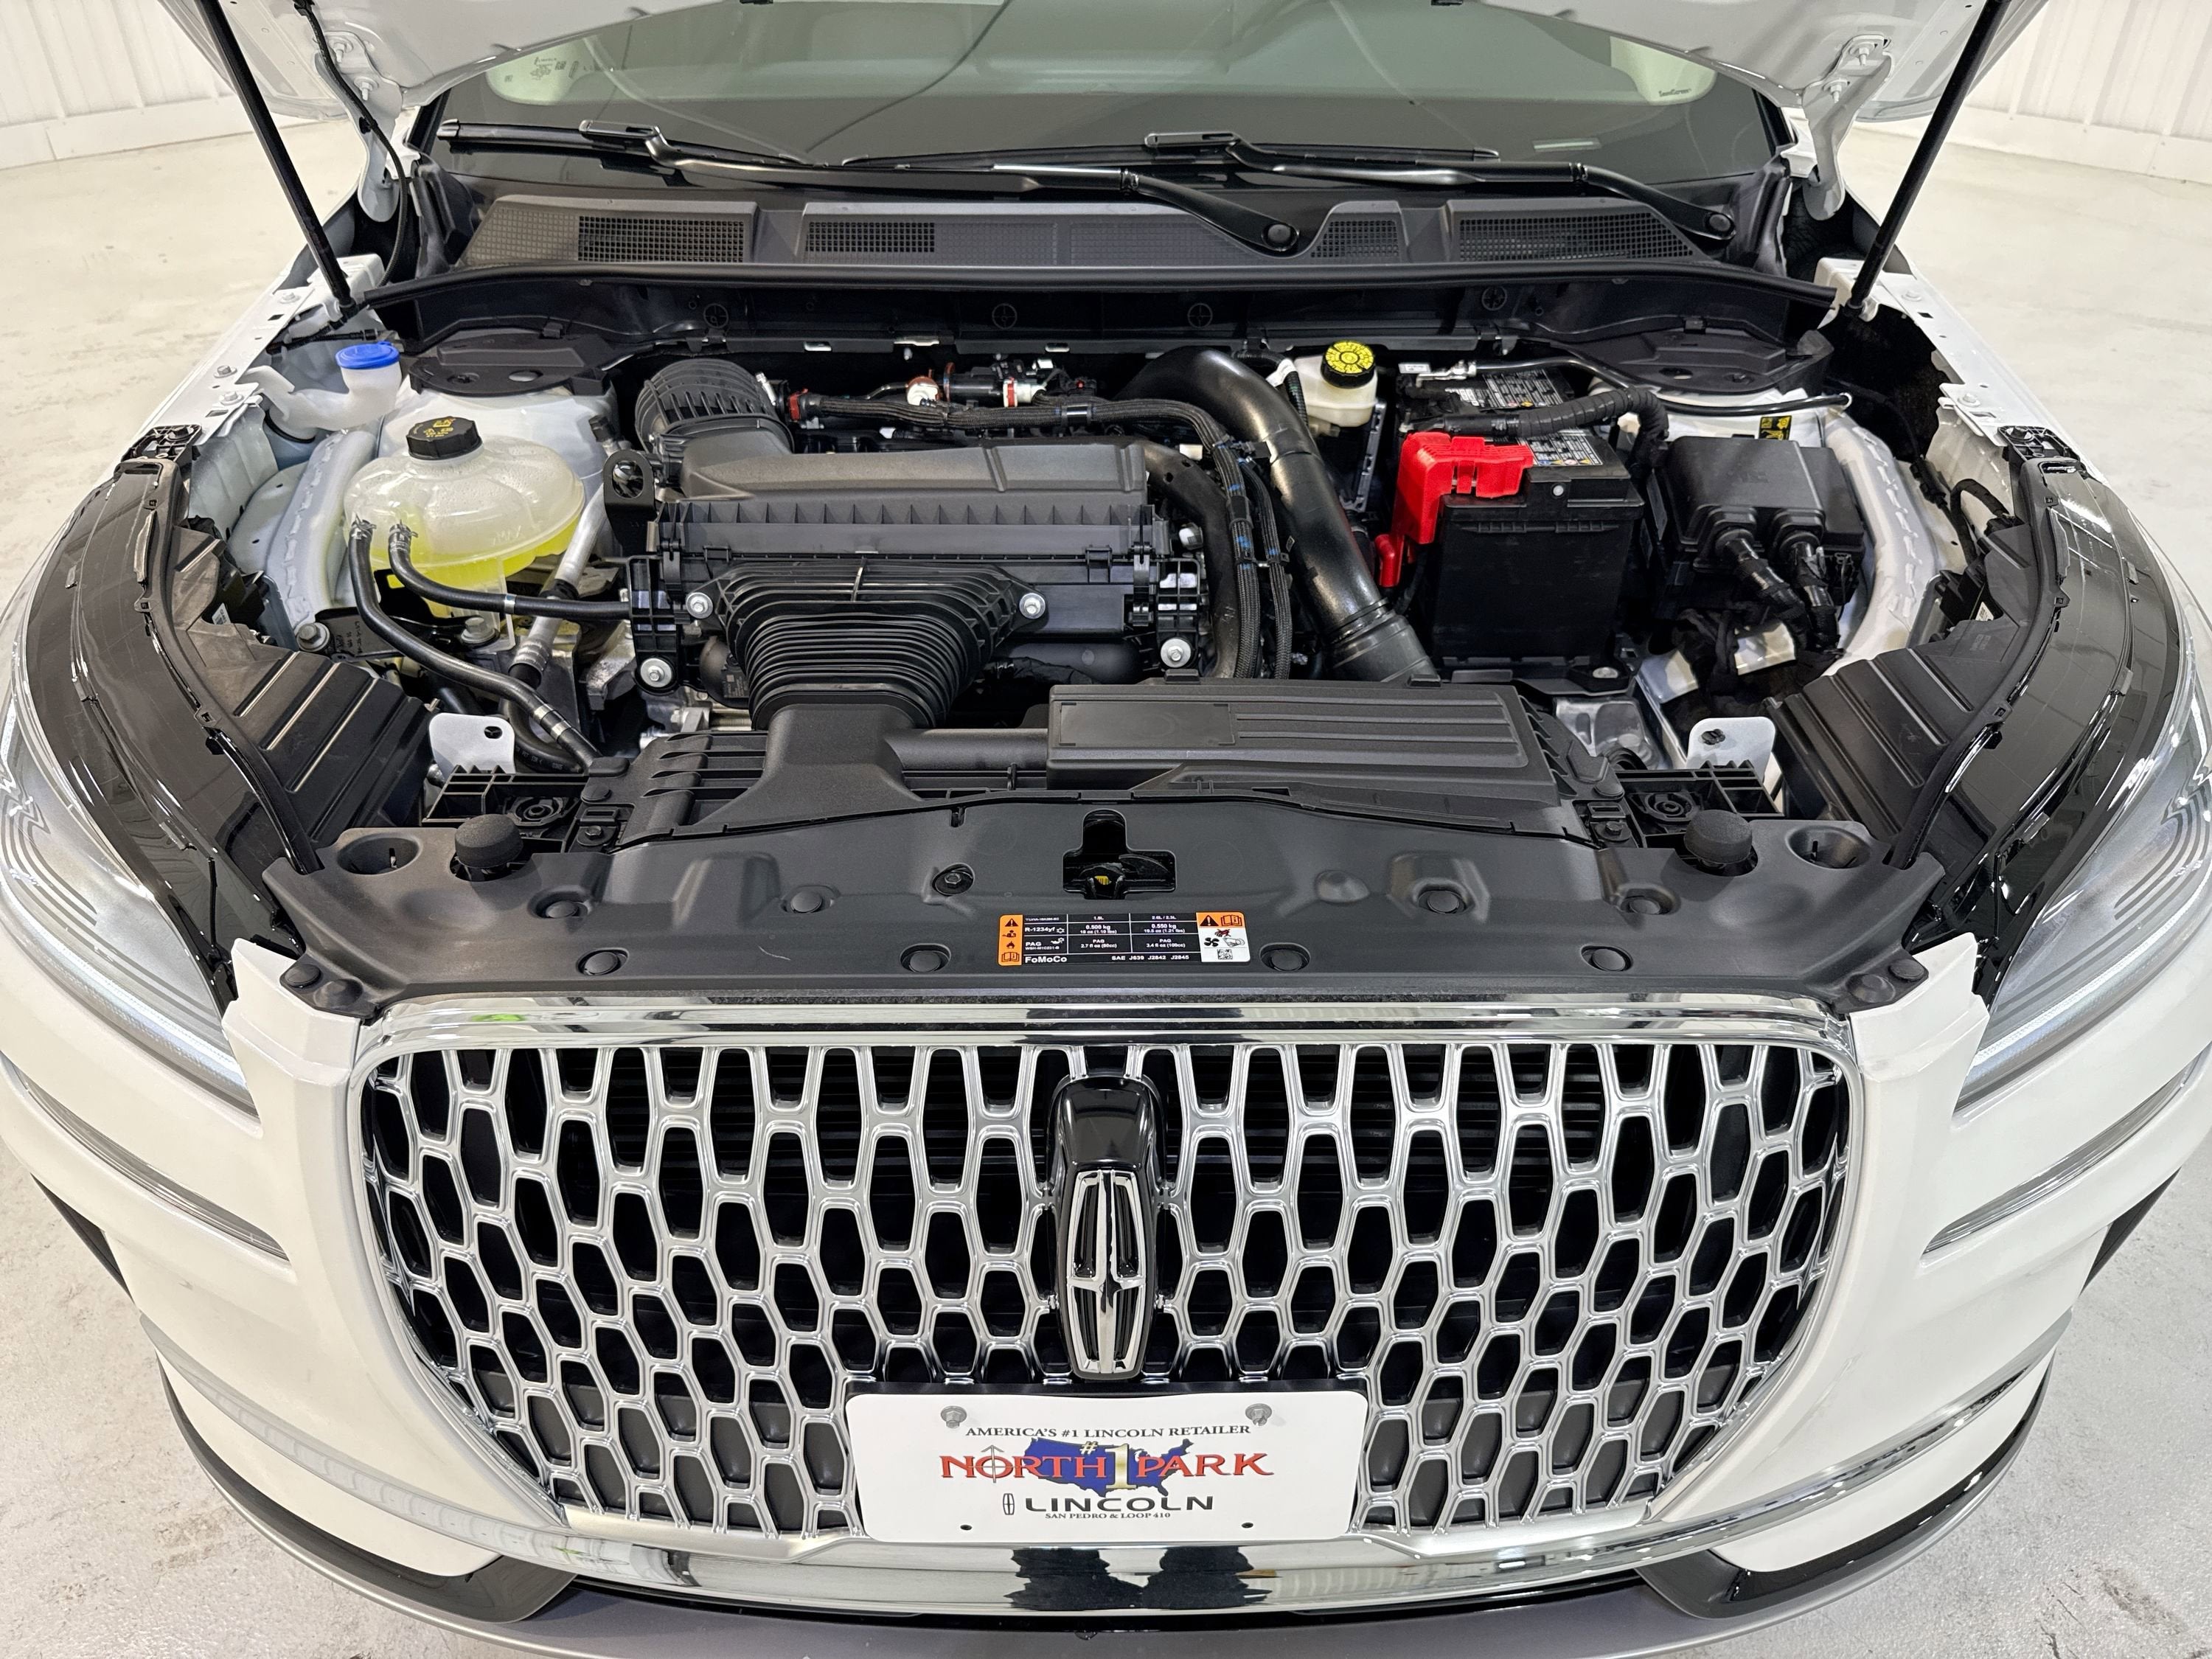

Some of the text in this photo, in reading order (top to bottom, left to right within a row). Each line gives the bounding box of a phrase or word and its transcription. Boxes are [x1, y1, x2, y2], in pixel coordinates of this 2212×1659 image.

[966, 1425, 1251, 1438] AMERICA'S #1 LINCOLN RETAILER
[939, 1453, 1275, 1478] NORTH PARK
[1025, 1495, 1214, 1512] LINCOLN
